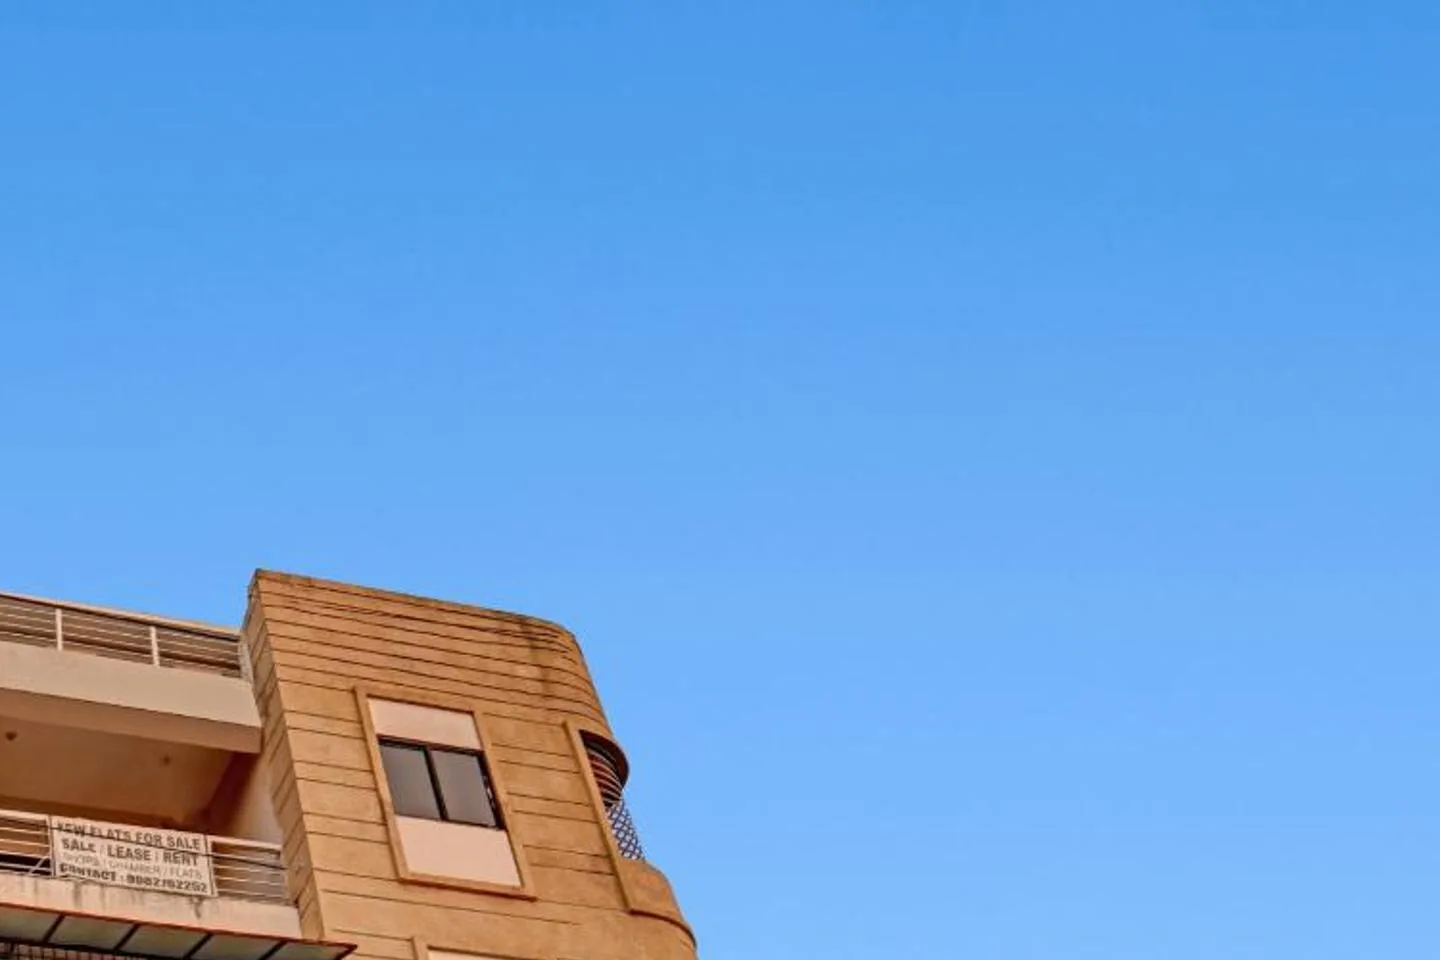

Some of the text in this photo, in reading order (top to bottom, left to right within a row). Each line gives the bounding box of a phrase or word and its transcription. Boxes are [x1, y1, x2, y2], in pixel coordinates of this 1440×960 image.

[61, 838, 198, 867] SALE LEASE RENT
[135, 831, 162, 848] FOR
[166, 835, 201, 850] SALE
